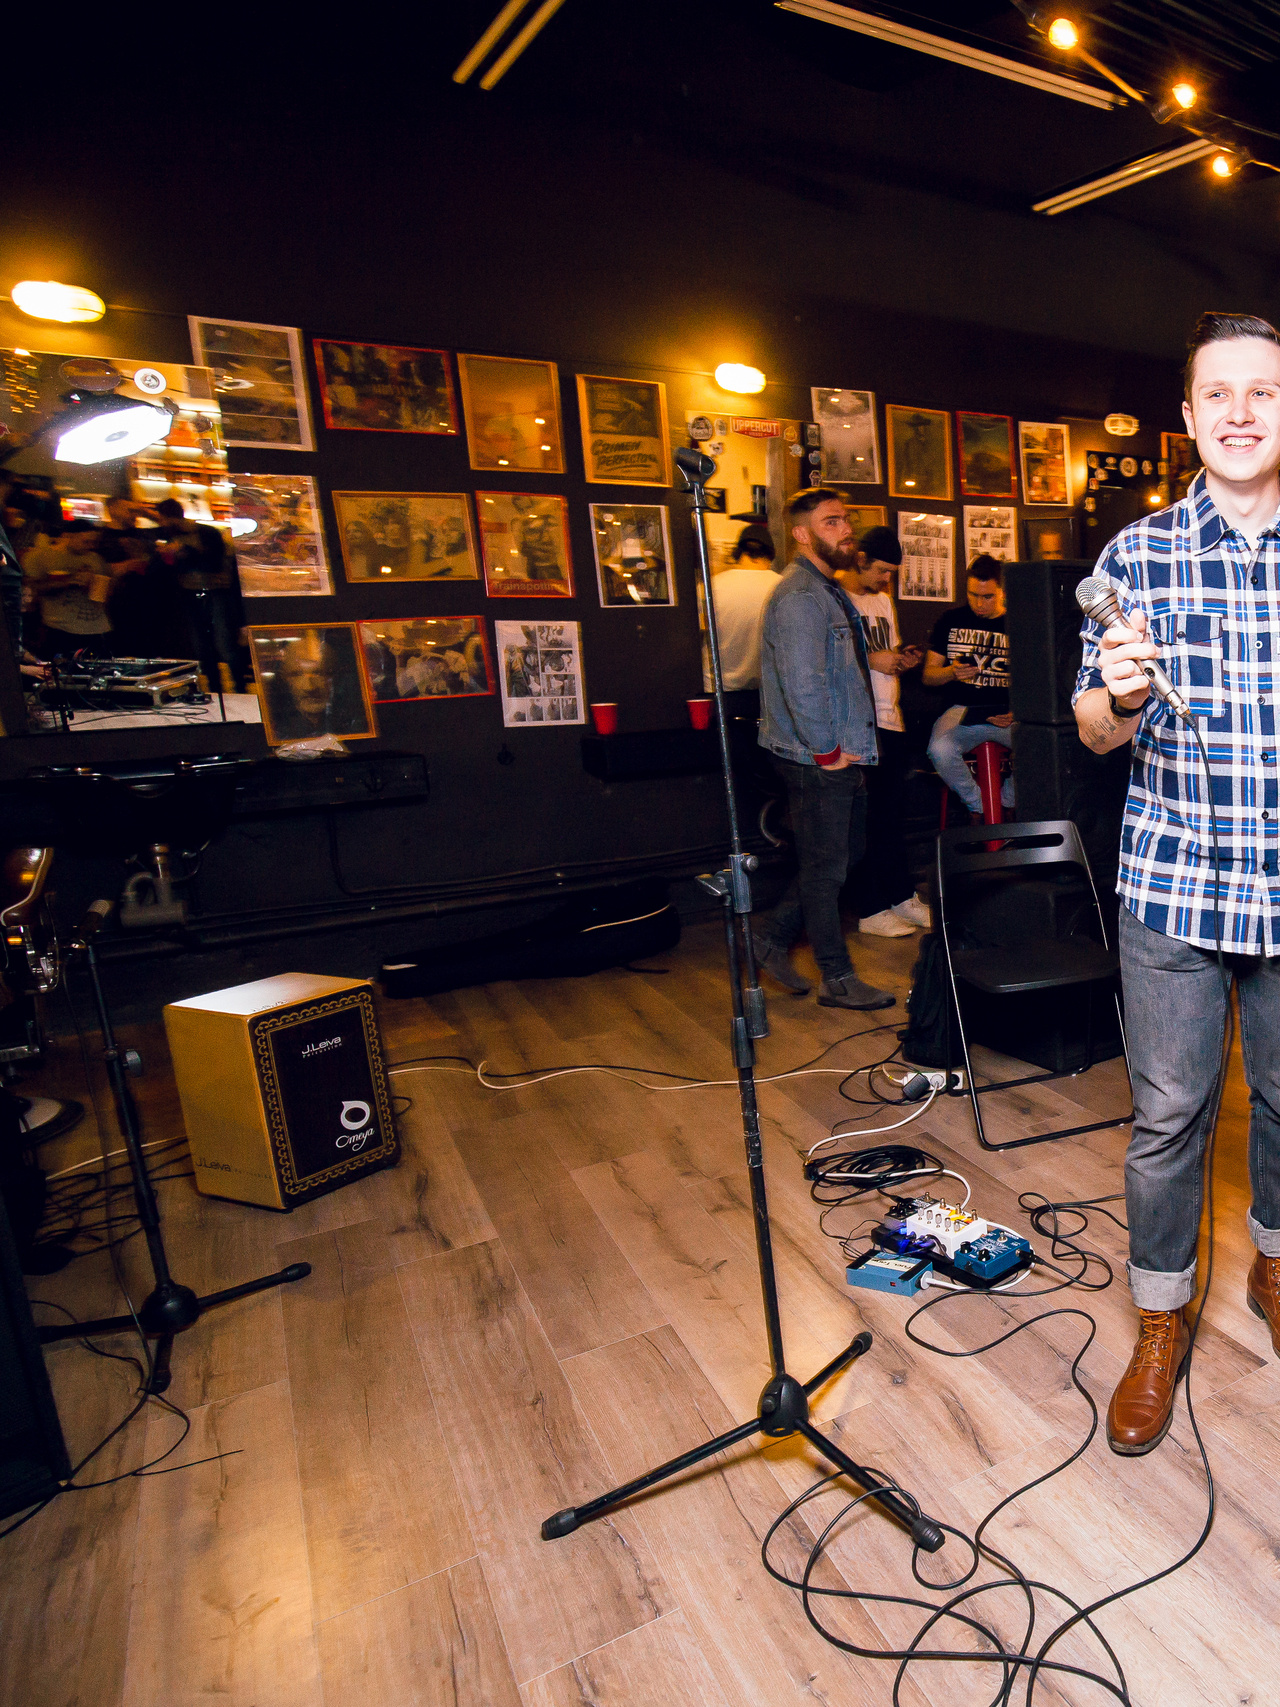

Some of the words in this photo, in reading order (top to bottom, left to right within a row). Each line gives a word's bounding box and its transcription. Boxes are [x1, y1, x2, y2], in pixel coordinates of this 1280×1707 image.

[732, 419, 778, 435] UPPERCUT
[957, 629, 989, 645] SIXTY
[302, 1037, 341, 1055] J.Leiva
[335, 1128, 375, 1151] Omeya
